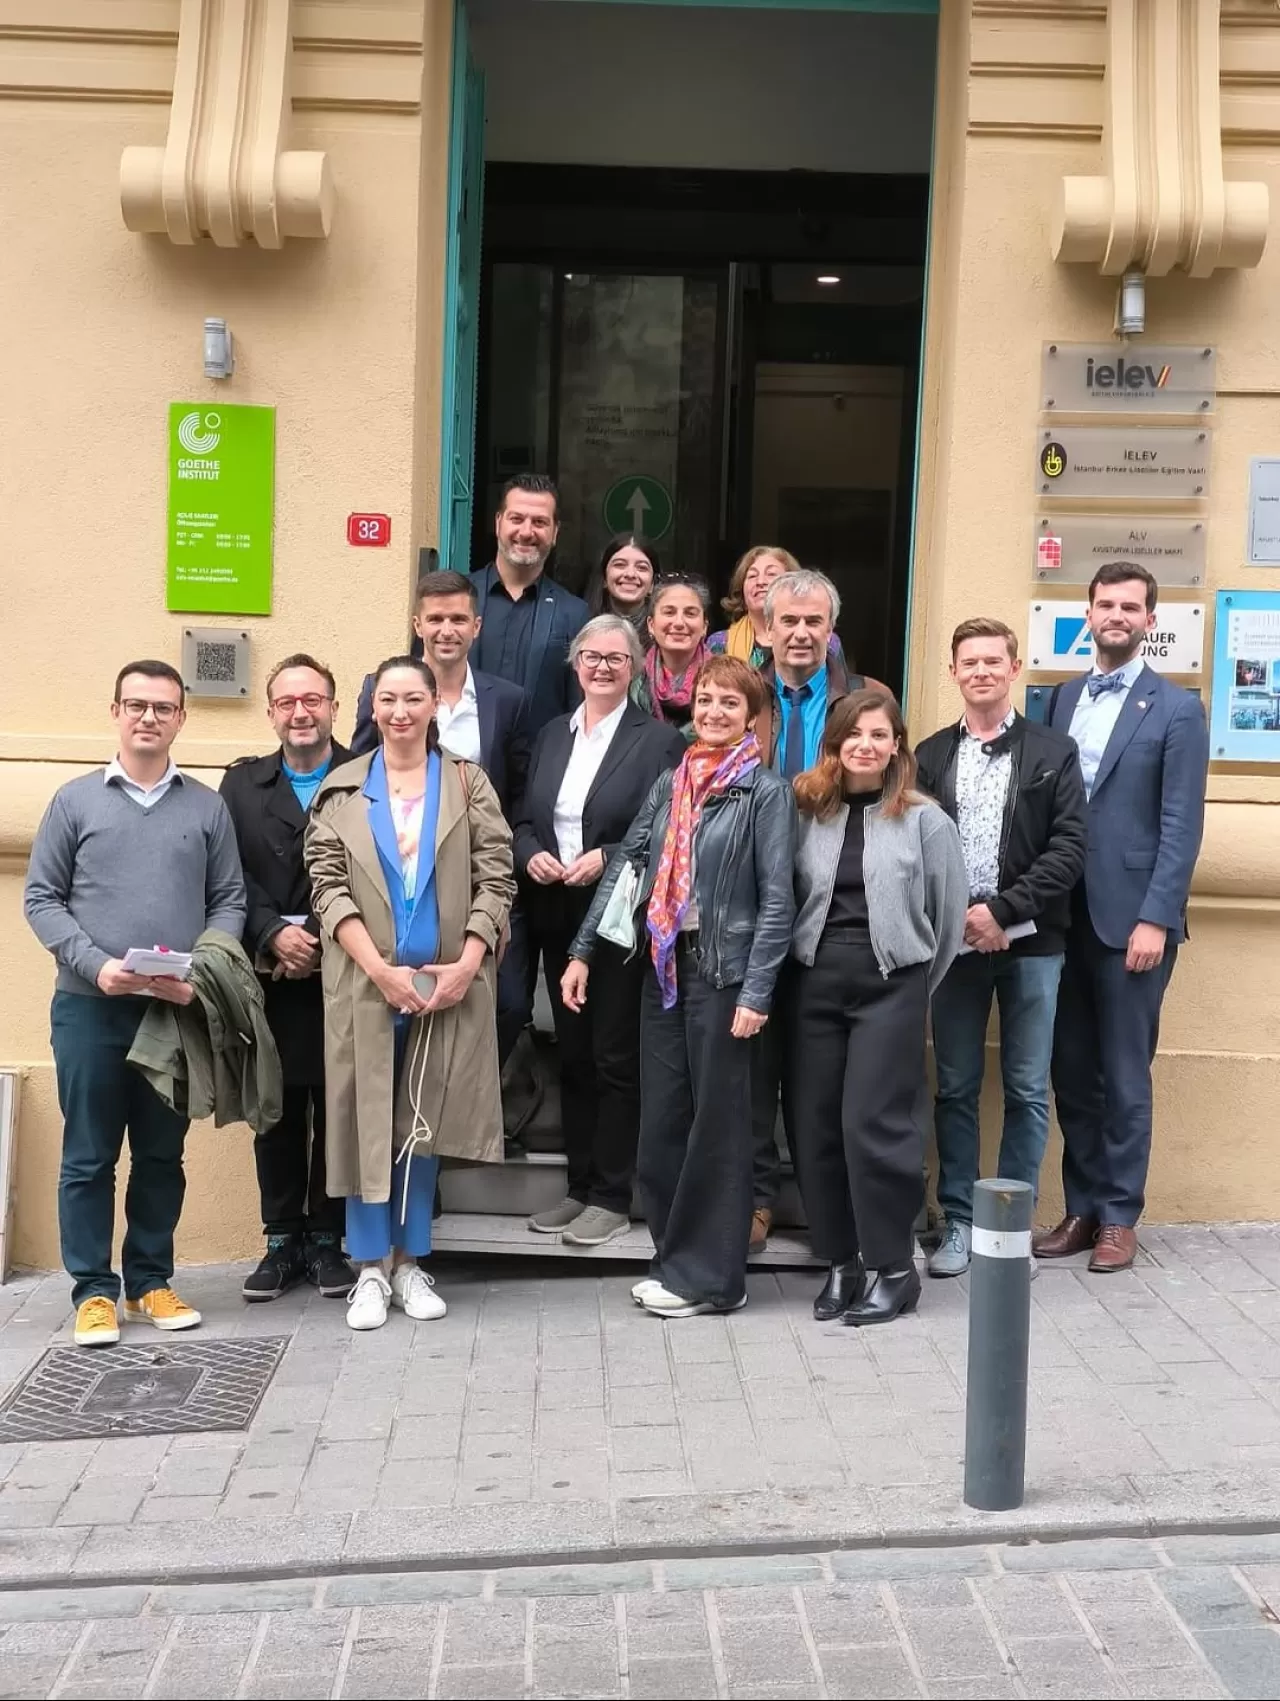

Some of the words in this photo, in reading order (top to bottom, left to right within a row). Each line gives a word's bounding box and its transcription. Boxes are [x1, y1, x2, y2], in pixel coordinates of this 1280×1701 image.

[177, 458, 220, 470] GOETHE
[177, 469, 220, 480] INSTITUT
[358, 519, 380, 540] 32
[1128, 530, 1148, 541] ALV
[1141, 632, 1176, 643] AUER
[1140, 645, 1168, 657] UNG
